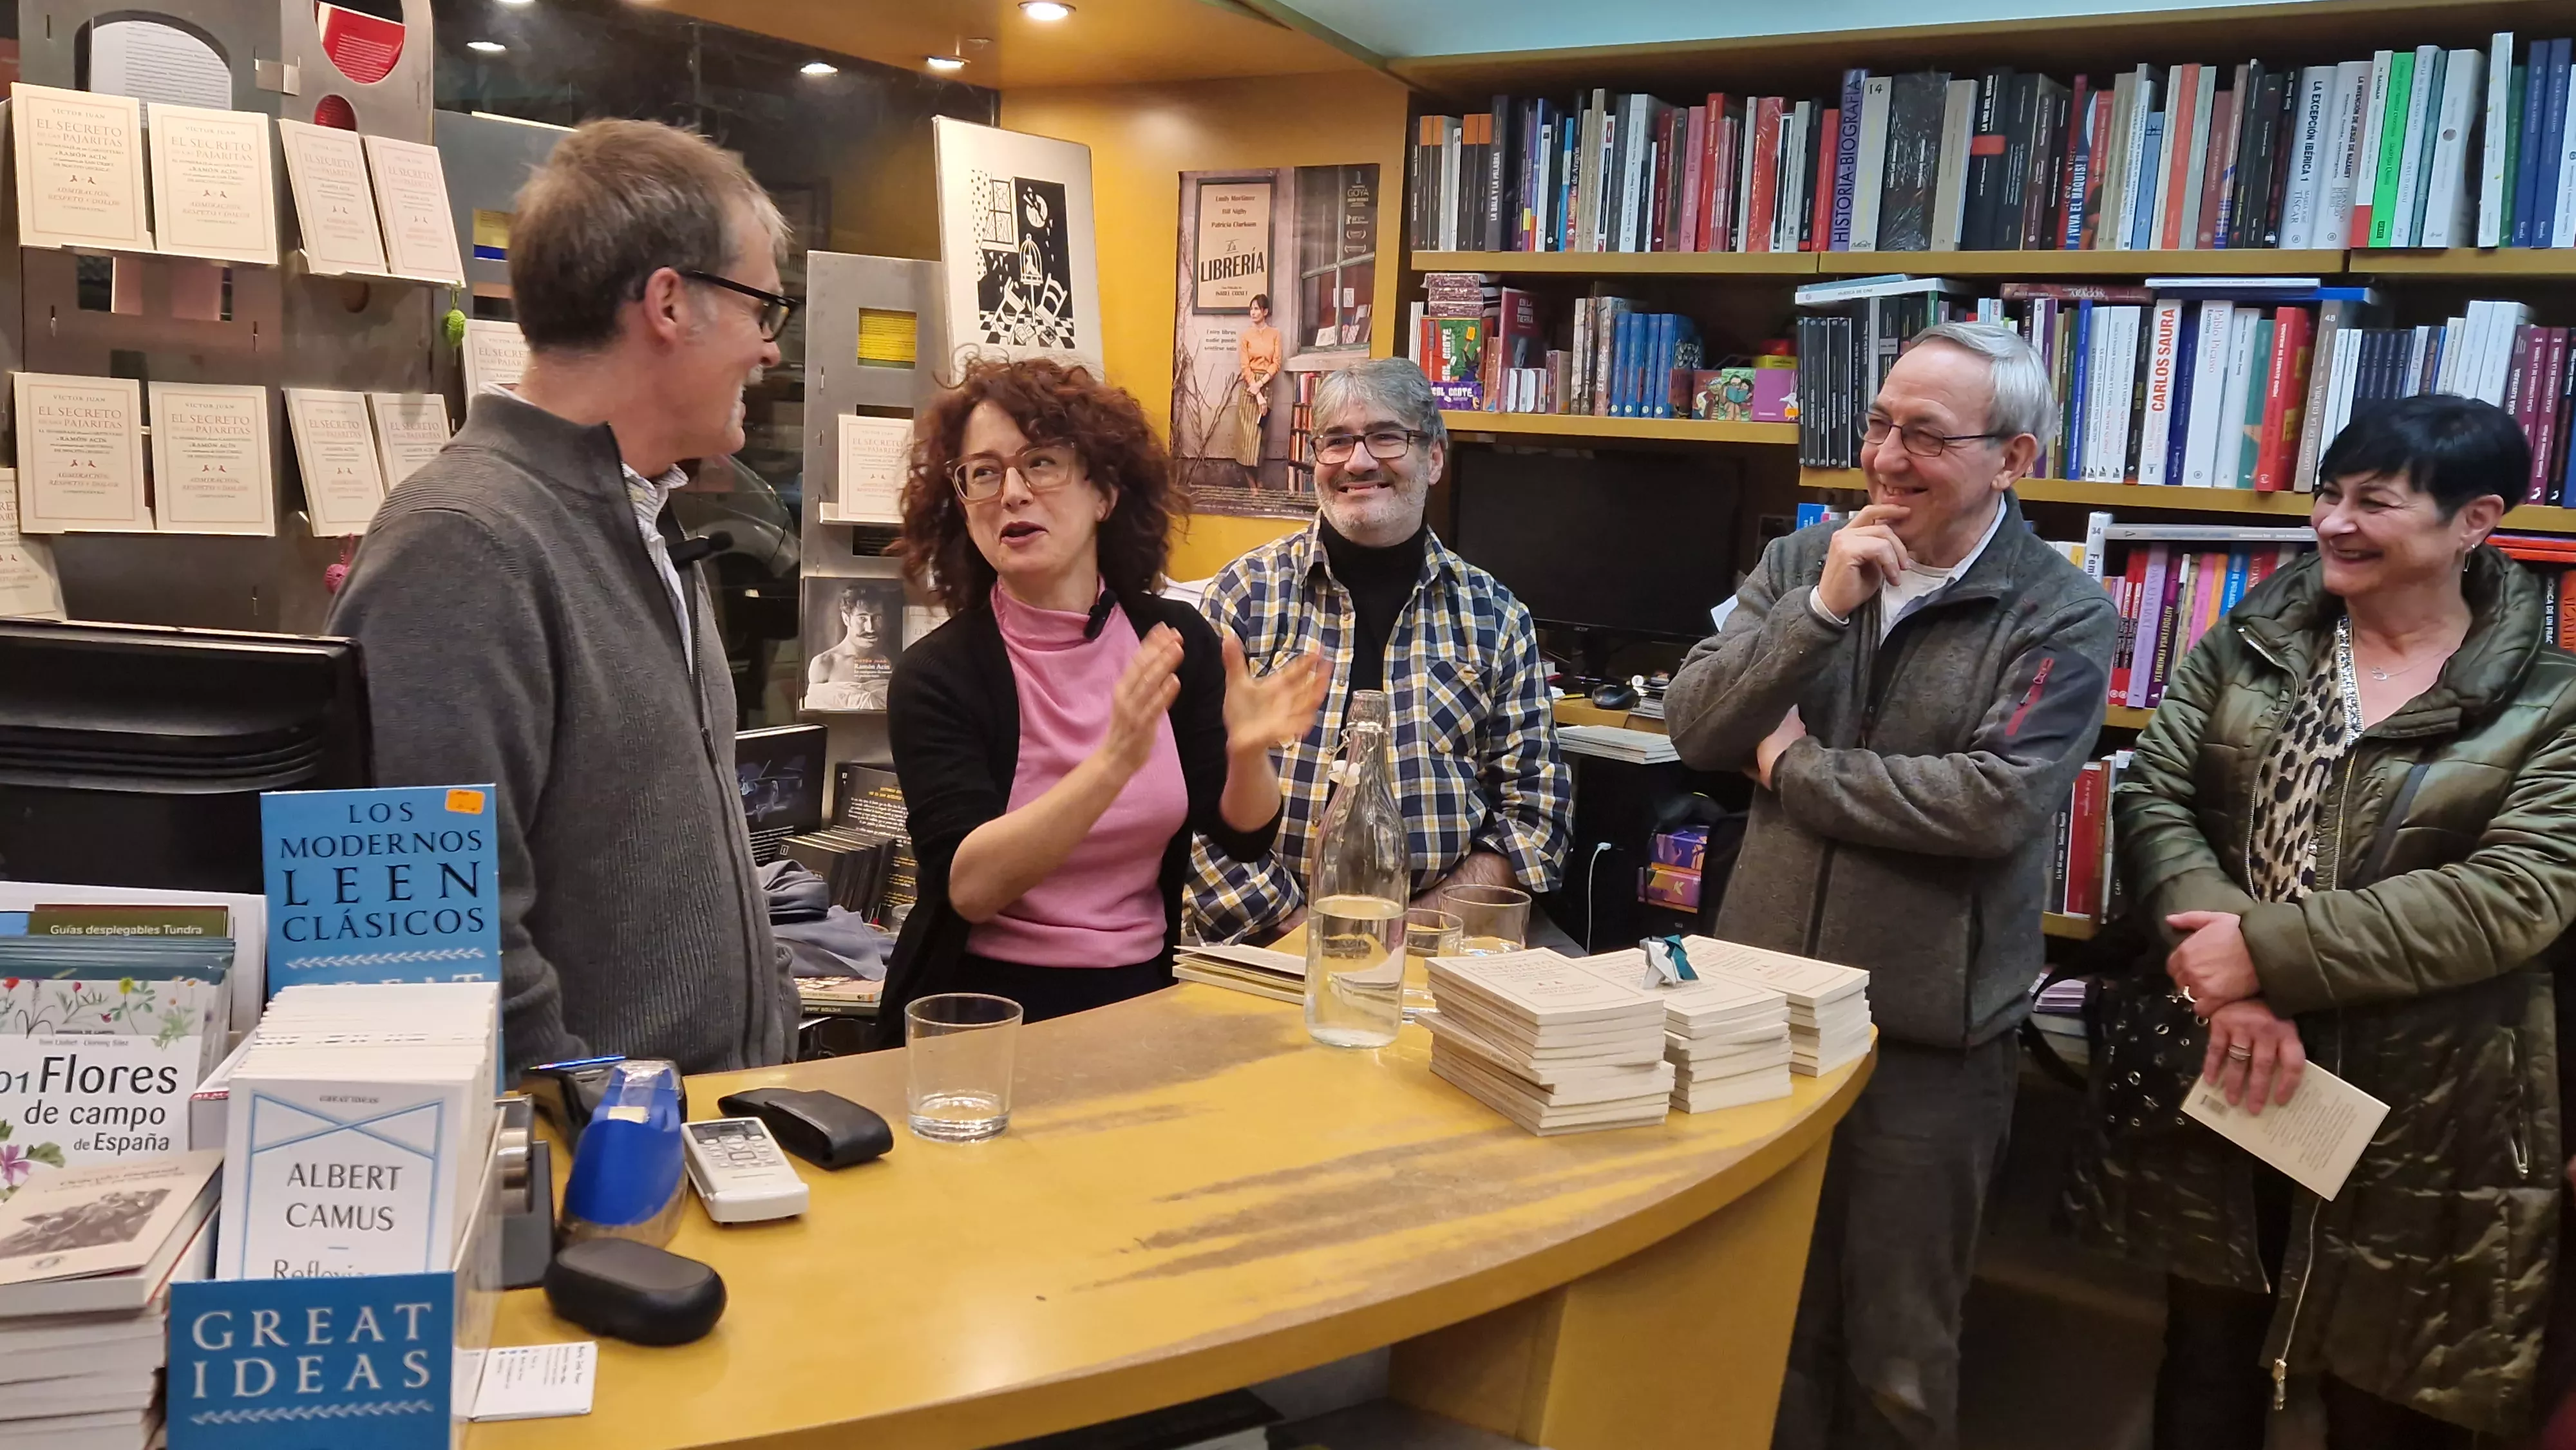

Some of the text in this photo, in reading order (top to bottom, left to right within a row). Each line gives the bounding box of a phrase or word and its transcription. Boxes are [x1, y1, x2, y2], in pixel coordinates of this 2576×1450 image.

[2313, 80, 2323, 91] LA
[2354, 84, 2363, 115] INVENCIÓN
[37, 118, 122, 137] EL SECRETO
[2306, 94, 2321, 140] EXCEPCIÓN
[63, 133, 122, 147] PAJARITAS
[171, 137, 252, 152] EL SECRETO
[196, 150, 252, 161] PAJARITAS
[316, 155, 354, 169] SECRETO
[1571, 147, 1581, 184] de Aragón
[2302, 142, 2317, 175] IBÉRICA
[399, 167, 434, 180] SECRETO
[1492, 180, 1499, 189] LA
[1347, 189, 1369, 197] GOYA
[2067, 164, 2087, 237] ¡VIVA EL MAQUIS!
[1490, 212, 1497, 221] LA
[2291, 191, 2304, 224] TÍSCAR
[1200, 247, 1265, 282] LIBRERÍA
[479, 348, 490, 357] EL
[2208, 309, 2224, 373] Pablo Picasso
[2151, 309, 2175, 412] CARLOS SAURA
[2508, 368, 2521, 415] GUÍA ILUSTRADA
[2528, 376, 2537, 398] LITERARIO
[2548, 376, 2557, 398] LITERARIO
[39, 406, 122, 419] EL SECRETO
[2526, 399, 2535, 412] ATLAS
[64, 419, 122, 429] PAJARITAS
[171, 413, 250, 425] EL SECRETO
[196, 426, 251, 435] PAJARITAS
[321, 420, 359, 429] SECRETO
[402, 422, 439, 431] SECRETO
[2304, 385, 2324, 470] LUGARES DE LA GUERRA
[2154, 605, 2173, 683] AUTODEFENSA FEMINISTA
[348, 801, 414, 824] LOS
[280, 829, 482, 860] MODERNOS
[283, 861, 482, 907] LEEN
[50, 925, 203, 936] Guías desplegables Tundra
[282, 906, 486, 944] CLÁSICOS
[39, 1053, 178, 1095] Flores
[23, 1098, 166, 1132] de campo
[73, 1132, 170, 1156] de España
[287, 1162, 404, 1191] ALBERT
[285, 1201, 395, 1232] CAMUS
[192, 1302, 433, 1351] GREAT
[191, 1350, 431, 1398] IDEAS
